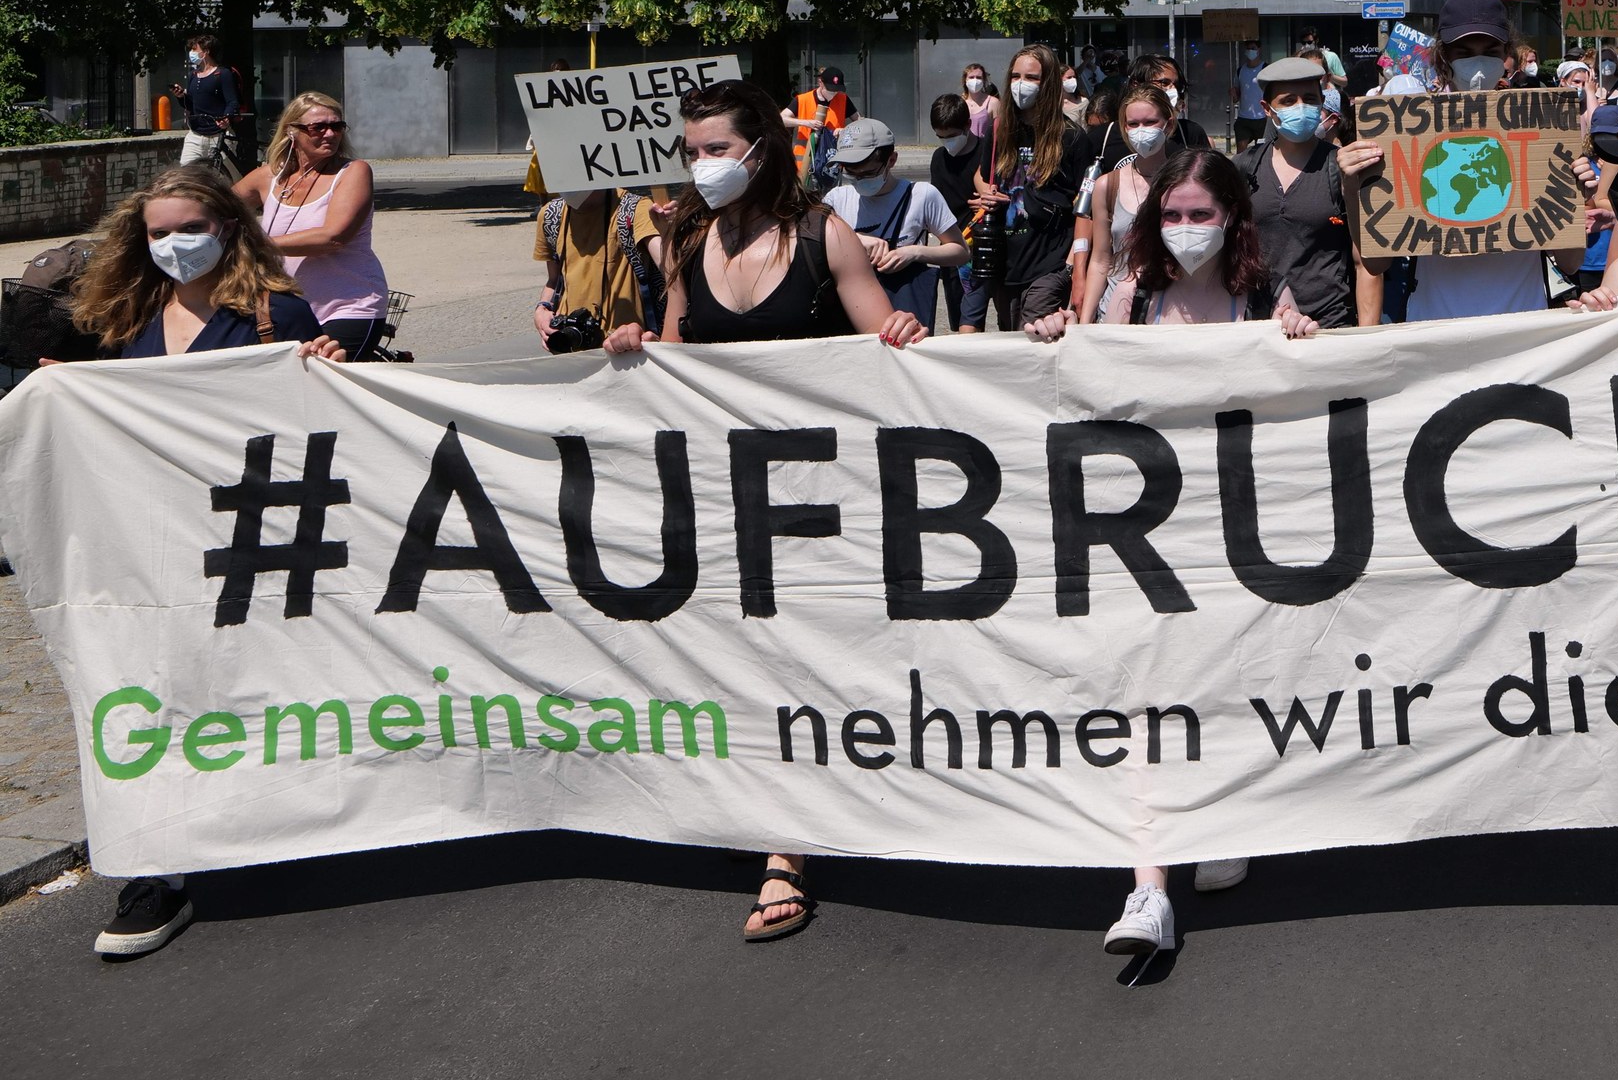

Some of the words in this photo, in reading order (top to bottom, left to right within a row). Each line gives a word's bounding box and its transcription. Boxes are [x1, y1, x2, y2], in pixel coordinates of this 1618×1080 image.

[1394, 23, 1428, 47] CLIMATE
[1565, 10, 1618, 31] ALIVE
[1349, 43, 1380, 54] adsXpre
[525, 75, 609, 109] LANG
[629, 61, 718, 100] LEBE
[601, 101, 672, 132] DAS
[1358, 94, 1488, 137] SYSTEM
[1497, 91, 1582, 132] CHANGE
[580, 135, 687, 181] KLIM
[1360, 176, 1504, 255] CLIMATE
[1507, 142, 1579, 251] CHANGE
[92, 666, 730, 780] Gemeinsam
[777, 669, 1200, 770] nehmen
[1249, 653, 1433, 758] wir
